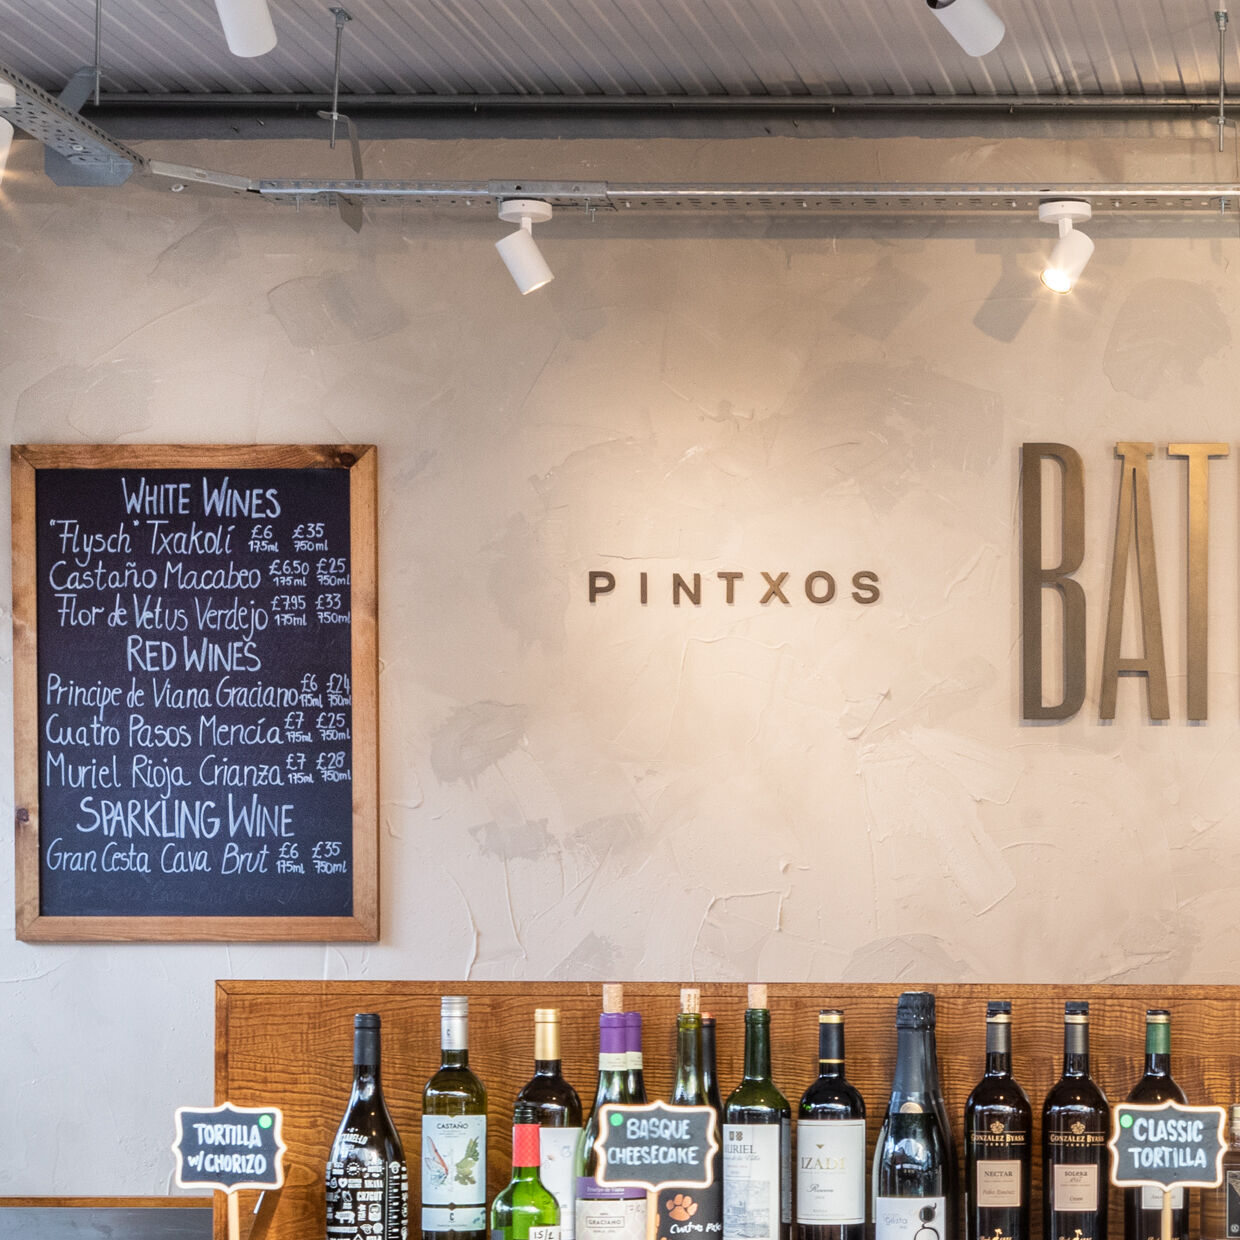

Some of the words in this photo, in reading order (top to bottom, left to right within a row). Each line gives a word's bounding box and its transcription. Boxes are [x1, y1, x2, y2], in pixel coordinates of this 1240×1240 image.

[122, 477, 191, 515] WHITE
[203, 477, 281, 519] WINES
[251, 524, 273, 539] £6
[291, 522, 326, 539] £35
[50, 560, 157, 591] Castaño
[164, 561, 261, 590] Macabeo
[268, 559, 310, 575] £6.50
[316, 557, 347, 575] £25
[588, 570, 882, 607] PINTXOS
[54, 593, 105, 627] Flor
[107, 593, 128, 627] de
[134, 593, 189, 632] Vetus
[195, 597, 269, 642] Verdejo
[127, 635, 177, 672] RED
[184, 635, 263, 672] WINES
[127, 677, 145, 708] de
[153, 678, 212, 710] Viana
[217, 676, 298, 709] Graciano
[301, 673, 318, 692] £6
[46, 714, 120, 747] Cuatro
[128, 714, 192, 748] Pasos
[284, 711, 304, 730] £7
[316, 711, 346, 729] £25
[46, 750, 121, 789] Muriel
[132, 754, 192, 800] Rioja
[200, 754, 285, 787] Crianza
[286, 753, 307, 771] £7
[316, 751, 346, 770] £28
[76, 796, 220, 839] SPARKLING
[229, 793, 295, 838] WINE
[46, 837, 97, 873] Gran
[102, 841, 151, 873] Cesta
[161, 843, 212, 873] Cava
[221, 842, 271, 875] Brut
[279, 841, 299, 859] £6
[312, 841, 343, 859] £35
[193, 1123, 263, 1149] TORTILLA
[437, 1120, 468, 1130] CASTAÑO
[627, 1118, 691, 1140] BASQUE
[1133, 1117, 1204, 1143] CLASSIC
[608, 1146, 700, 1165] CHEESECAKE
[800, 1157, 846, 1169] IZADI
[1128, 1147, 1207, 1169] TORTILLA
